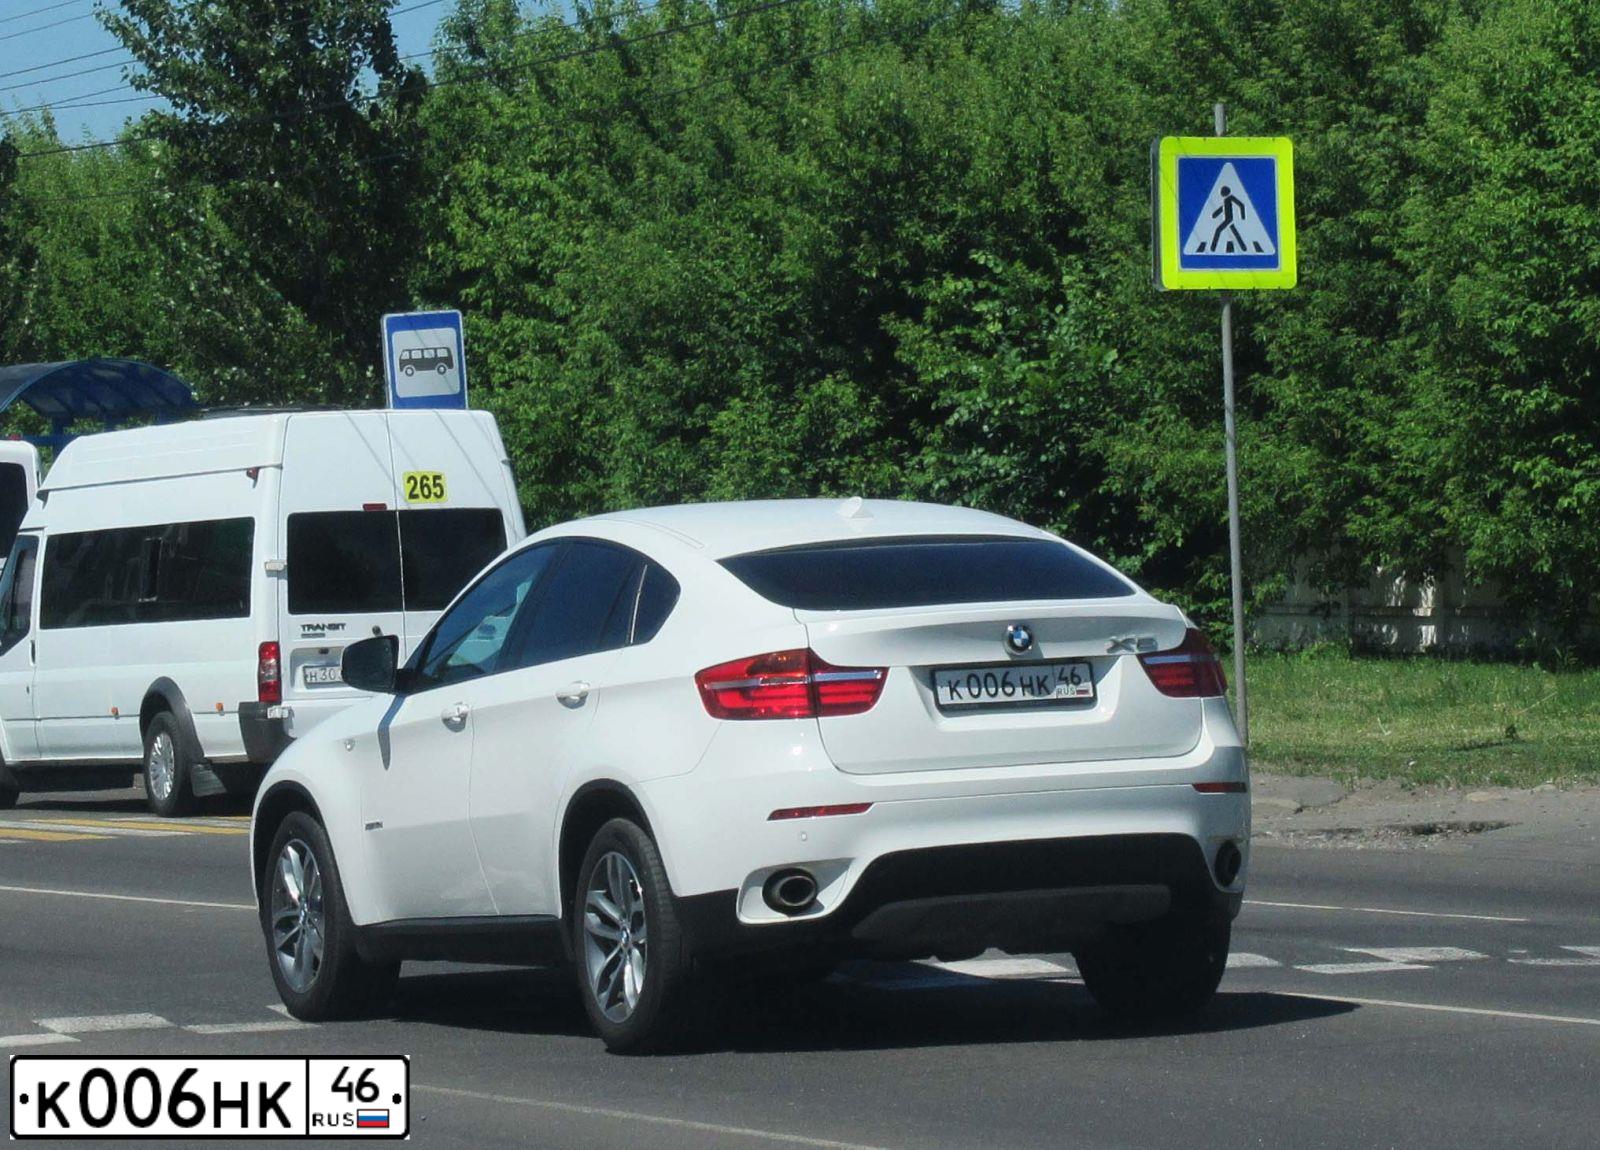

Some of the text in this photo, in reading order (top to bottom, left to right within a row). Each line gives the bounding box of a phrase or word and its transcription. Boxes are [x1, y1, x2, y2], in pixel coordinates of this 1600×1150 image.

[406, 474, 445, 499] 265
[301, 622, 347, 631] TRANSIT
[1058, 666, 1082, 686] 46
[1056, 687, 1076, 699] RUS
